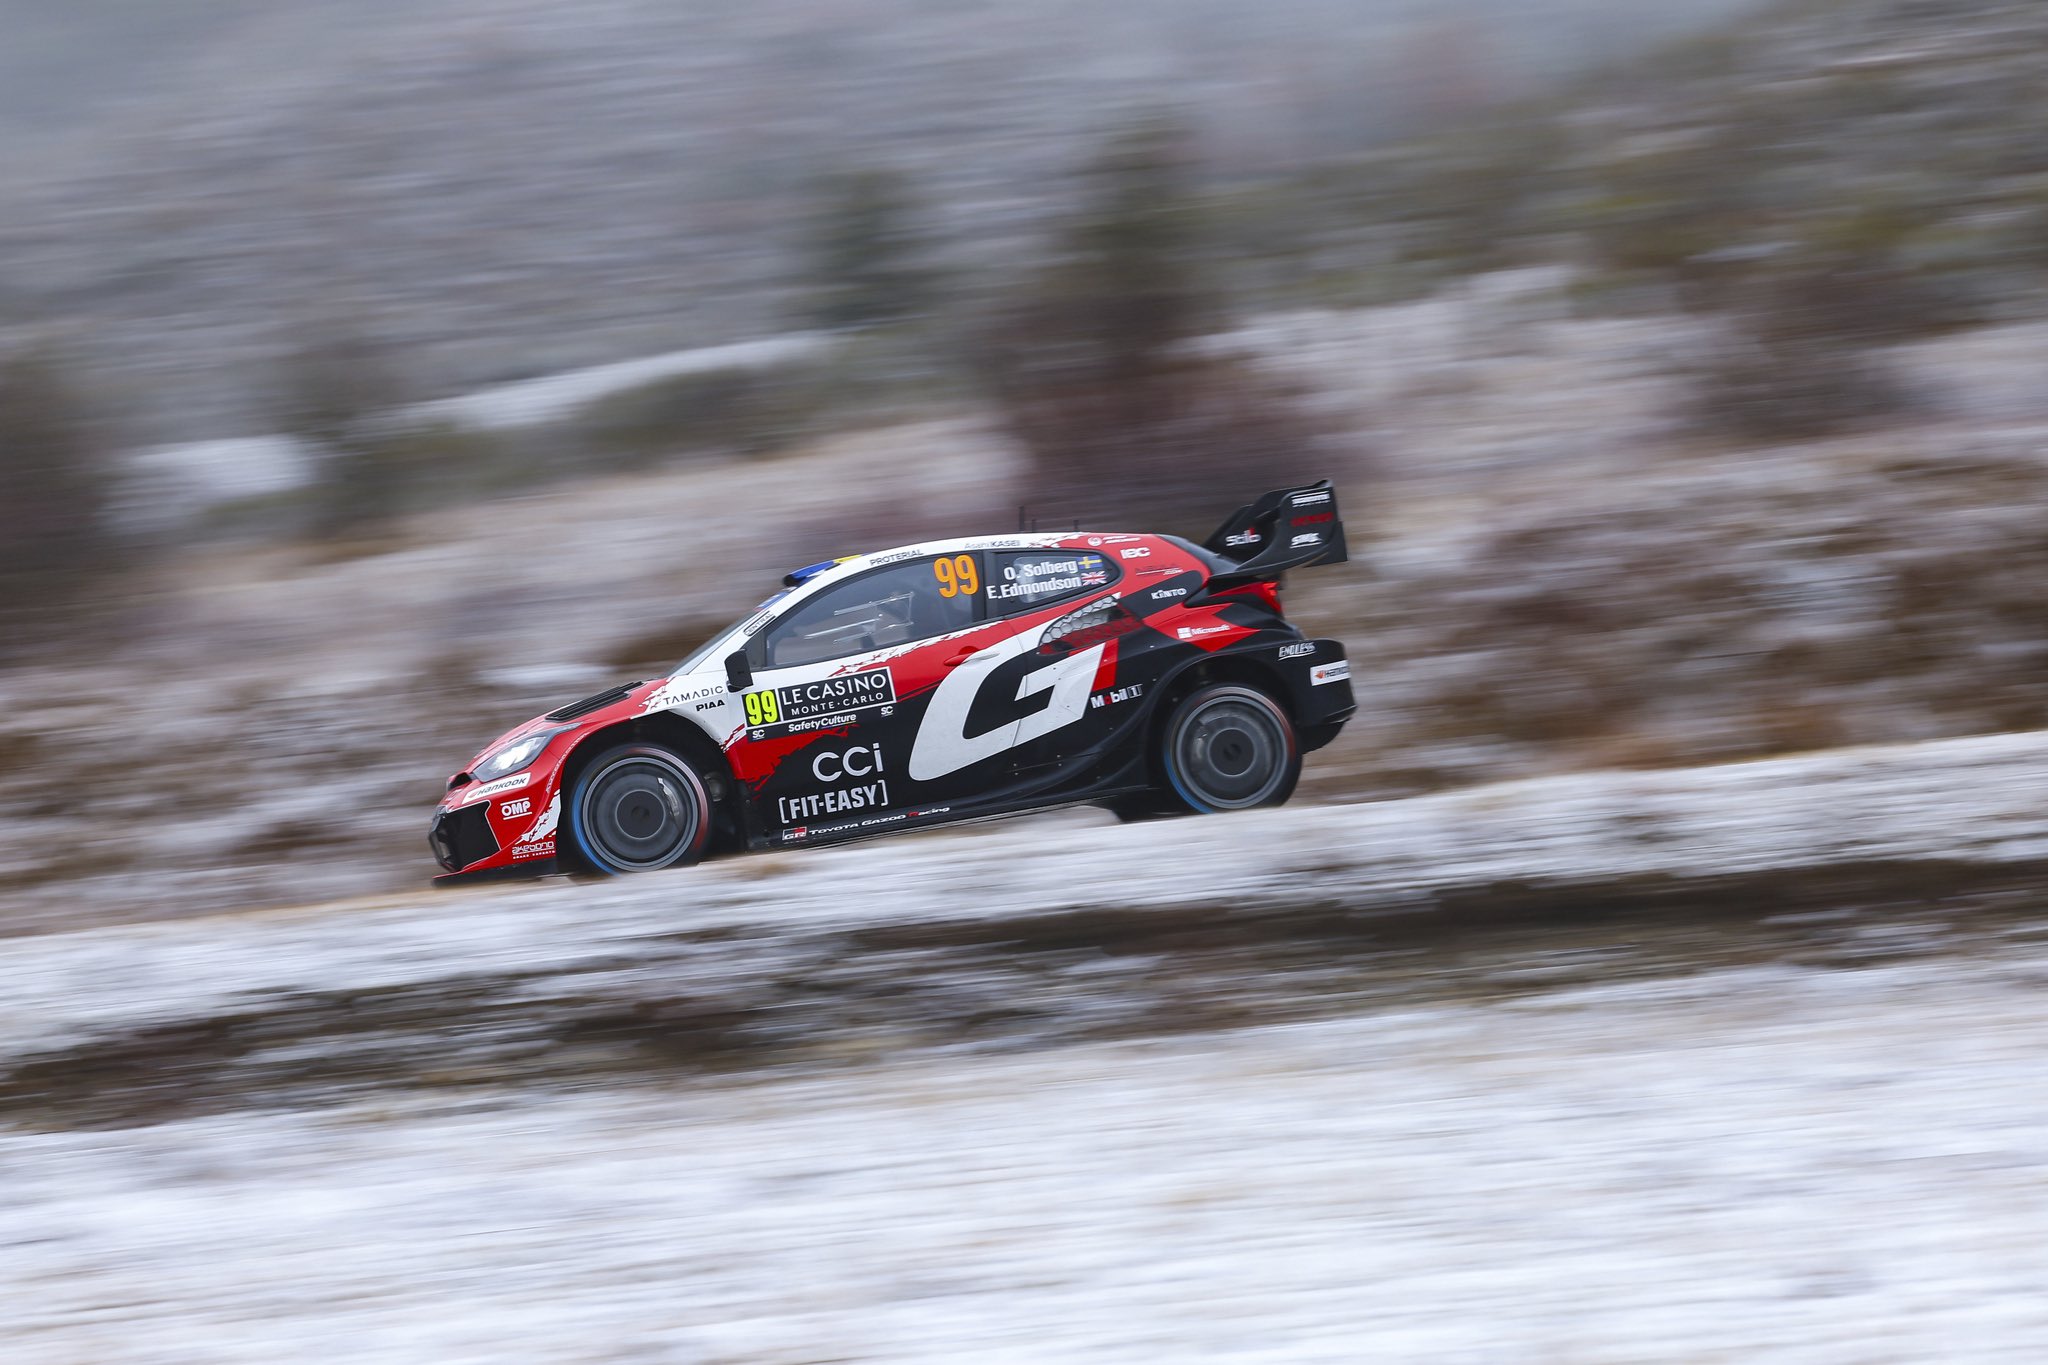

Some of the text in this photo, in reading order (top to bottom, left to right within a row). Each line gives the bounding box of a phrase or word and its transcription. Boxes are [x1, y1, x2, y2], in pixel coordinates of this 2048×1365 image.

[990, 540, 1021, 548] KASEI
[870, 549, 925, 567] PROTERIAL
[933, 554, 980, 599] 99
[1003, 561, 1078, 581] O. Solberg
[986, 576, 1082, 600] E.Edmondson
[1279, 641, 1316, 658] ENDLESS
[664, 685, 725, 705] TAMADIC
[781, 673, 887, 706] LE CASINO
[1090, 688, 1129, 709] Mobil
[696, 699, 726, 712] PIAA
[745, 690, 779, 726] 99
[880, 705, 894, 716] SC
[788, 713, 857, 733] SafetyCulture
[752, 729, 765, 739] SC
[501, 800, 532, 817] OMP
[783, 831, 806, 841] GR
[908, 806, 950, 818] Racing
